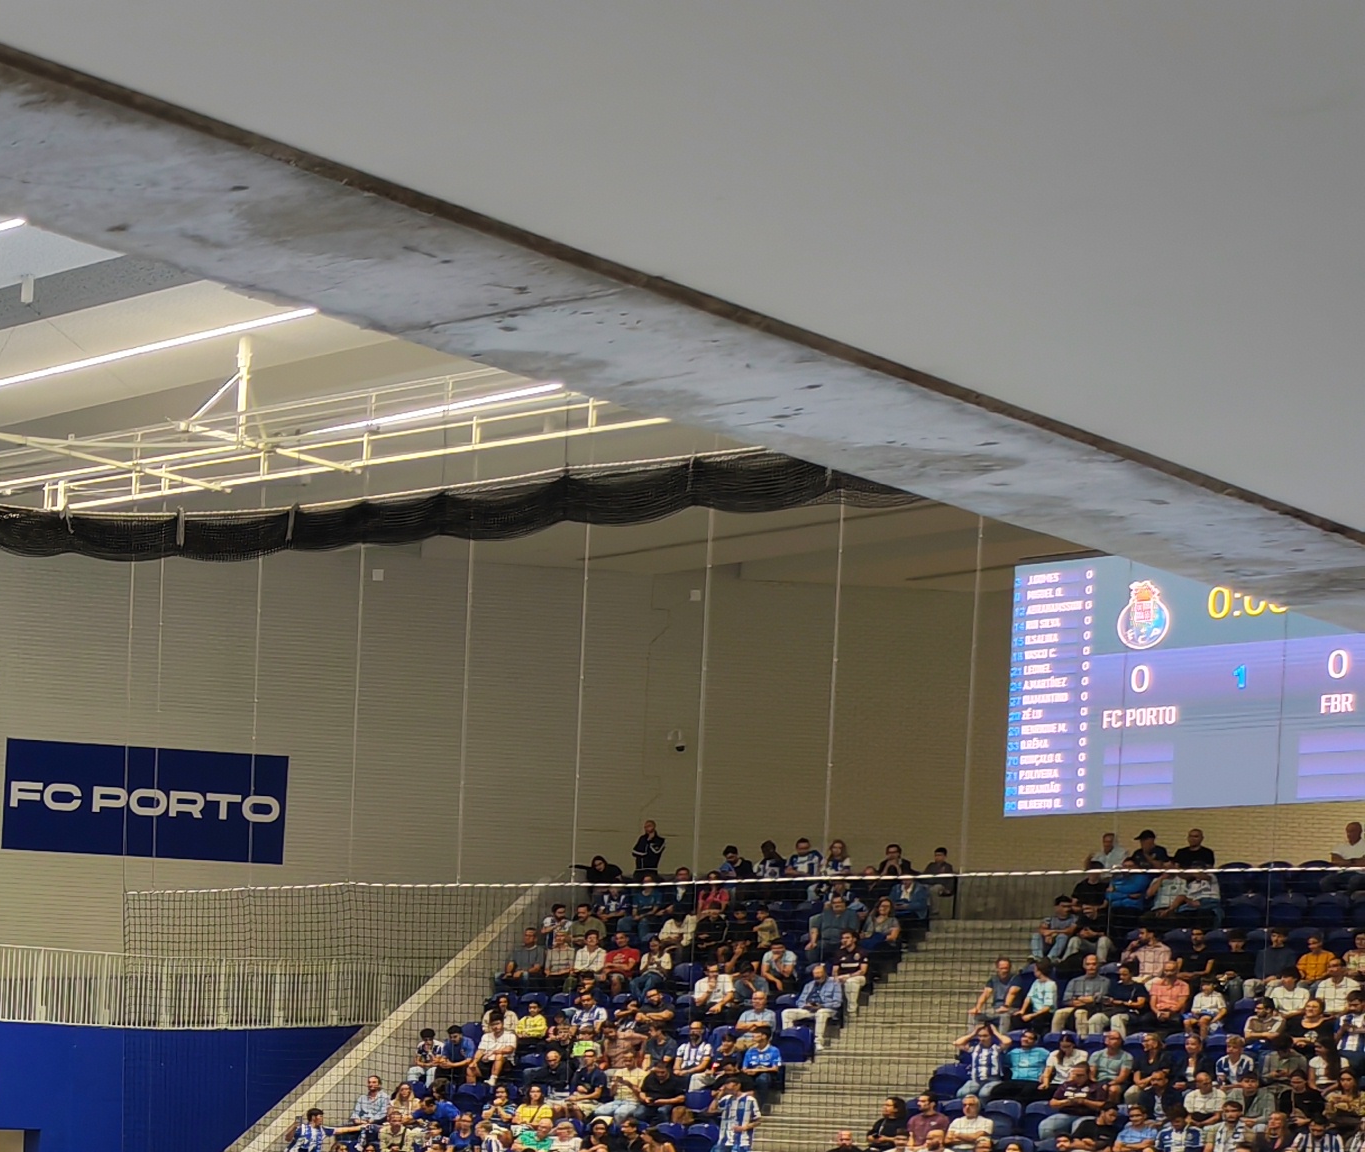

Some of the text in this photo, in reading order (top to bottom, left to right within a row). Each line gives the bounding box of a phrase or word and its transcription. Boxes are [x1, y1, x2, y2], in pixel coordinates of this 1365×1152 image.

[1208, 586, 1288, 620] 0:0
[1233, 664, 1248, 689] 1
[1327, 649, 1349, 679] 0
[1130, 665, 1150, 693] 0
[1102, 706, 1176, 729] FC PORTO
[1320, 693, 1355, 714] FBR
[9, 780, 280, 823] FC PORTO
